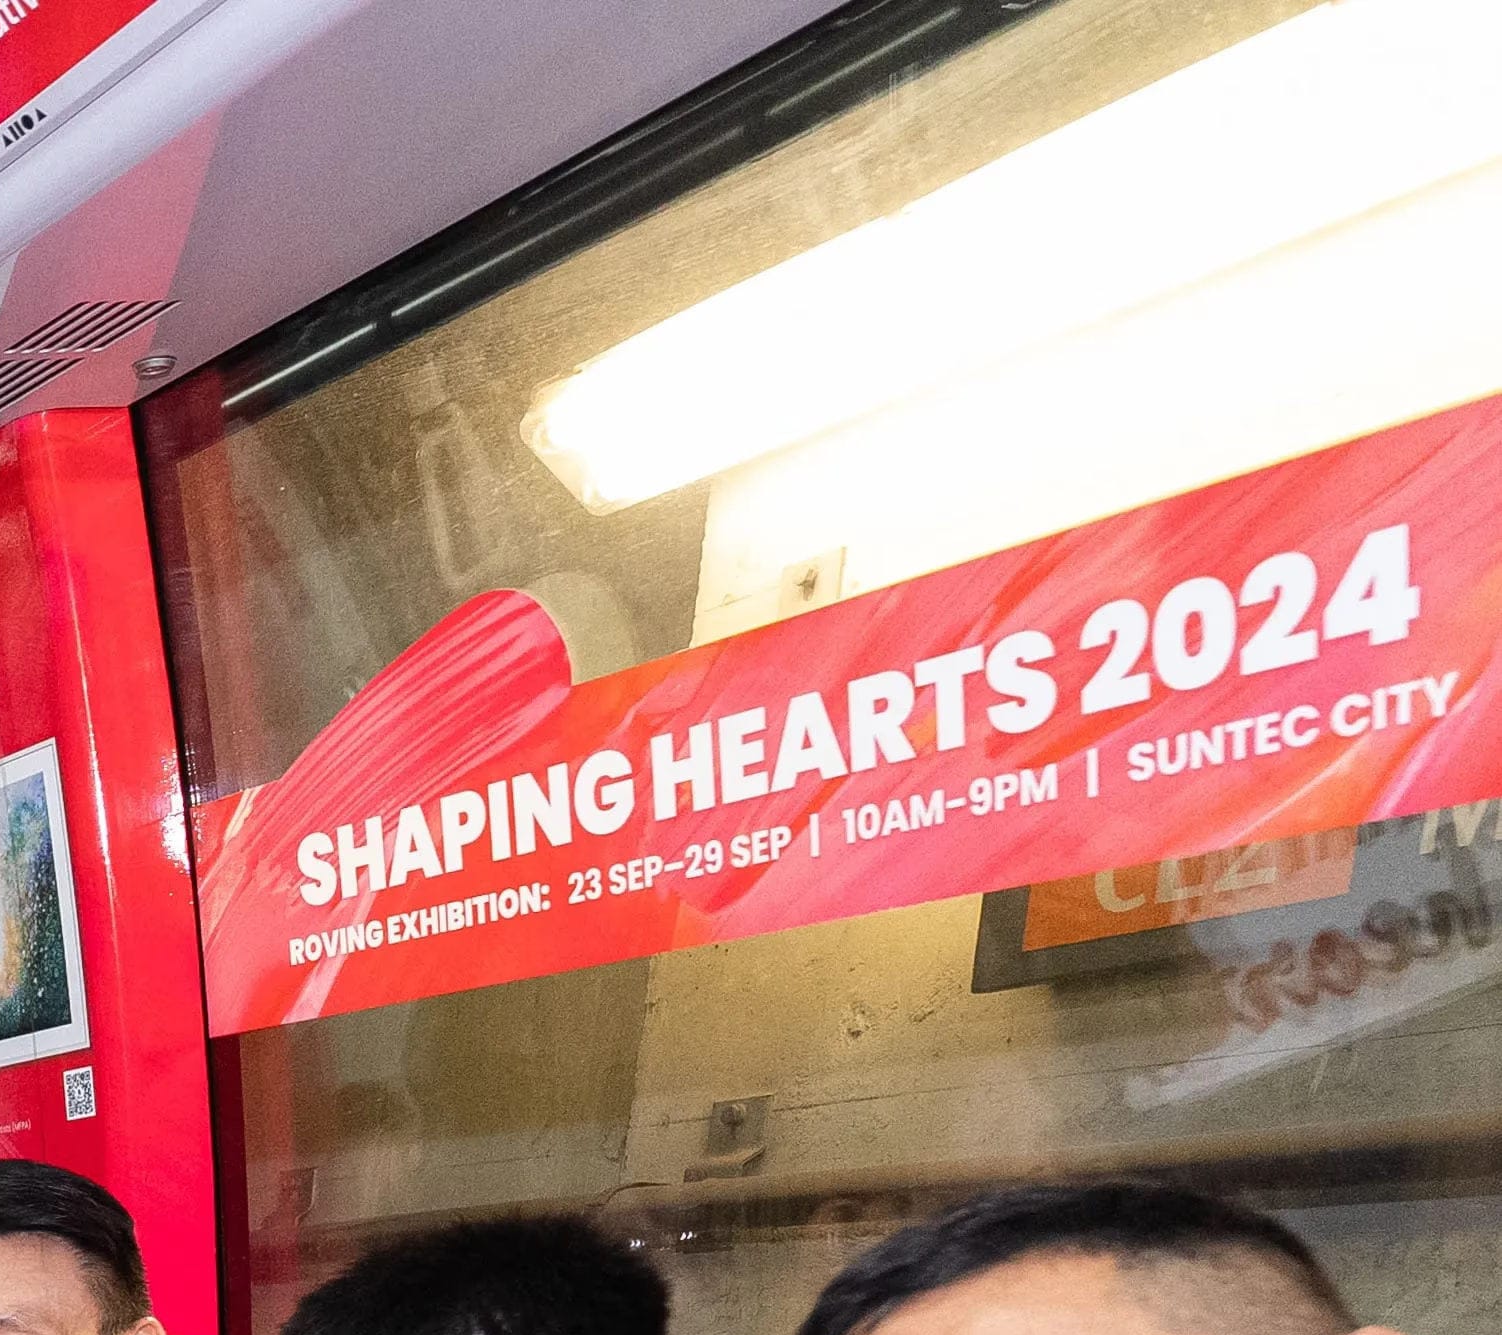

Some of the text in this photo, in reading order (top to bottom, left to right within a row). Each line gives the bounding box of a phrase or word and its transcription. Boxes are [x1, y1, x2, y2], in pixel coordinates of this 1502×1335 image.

[288, 920, 384, 967] ROVING
[386, 881, 551, 946] EXHIBITION:
[568, 867, 603, 907] 23
[731, 824, 793, 874] SEP
[840, 766, 1059, 848] 10AM-9PM
[1125, 701, 1320, 785] SUNTEC
[1332, 671, 1462, 740] CITY
[295, 522, 1422, 908] SHAPING HEARTS 2024
